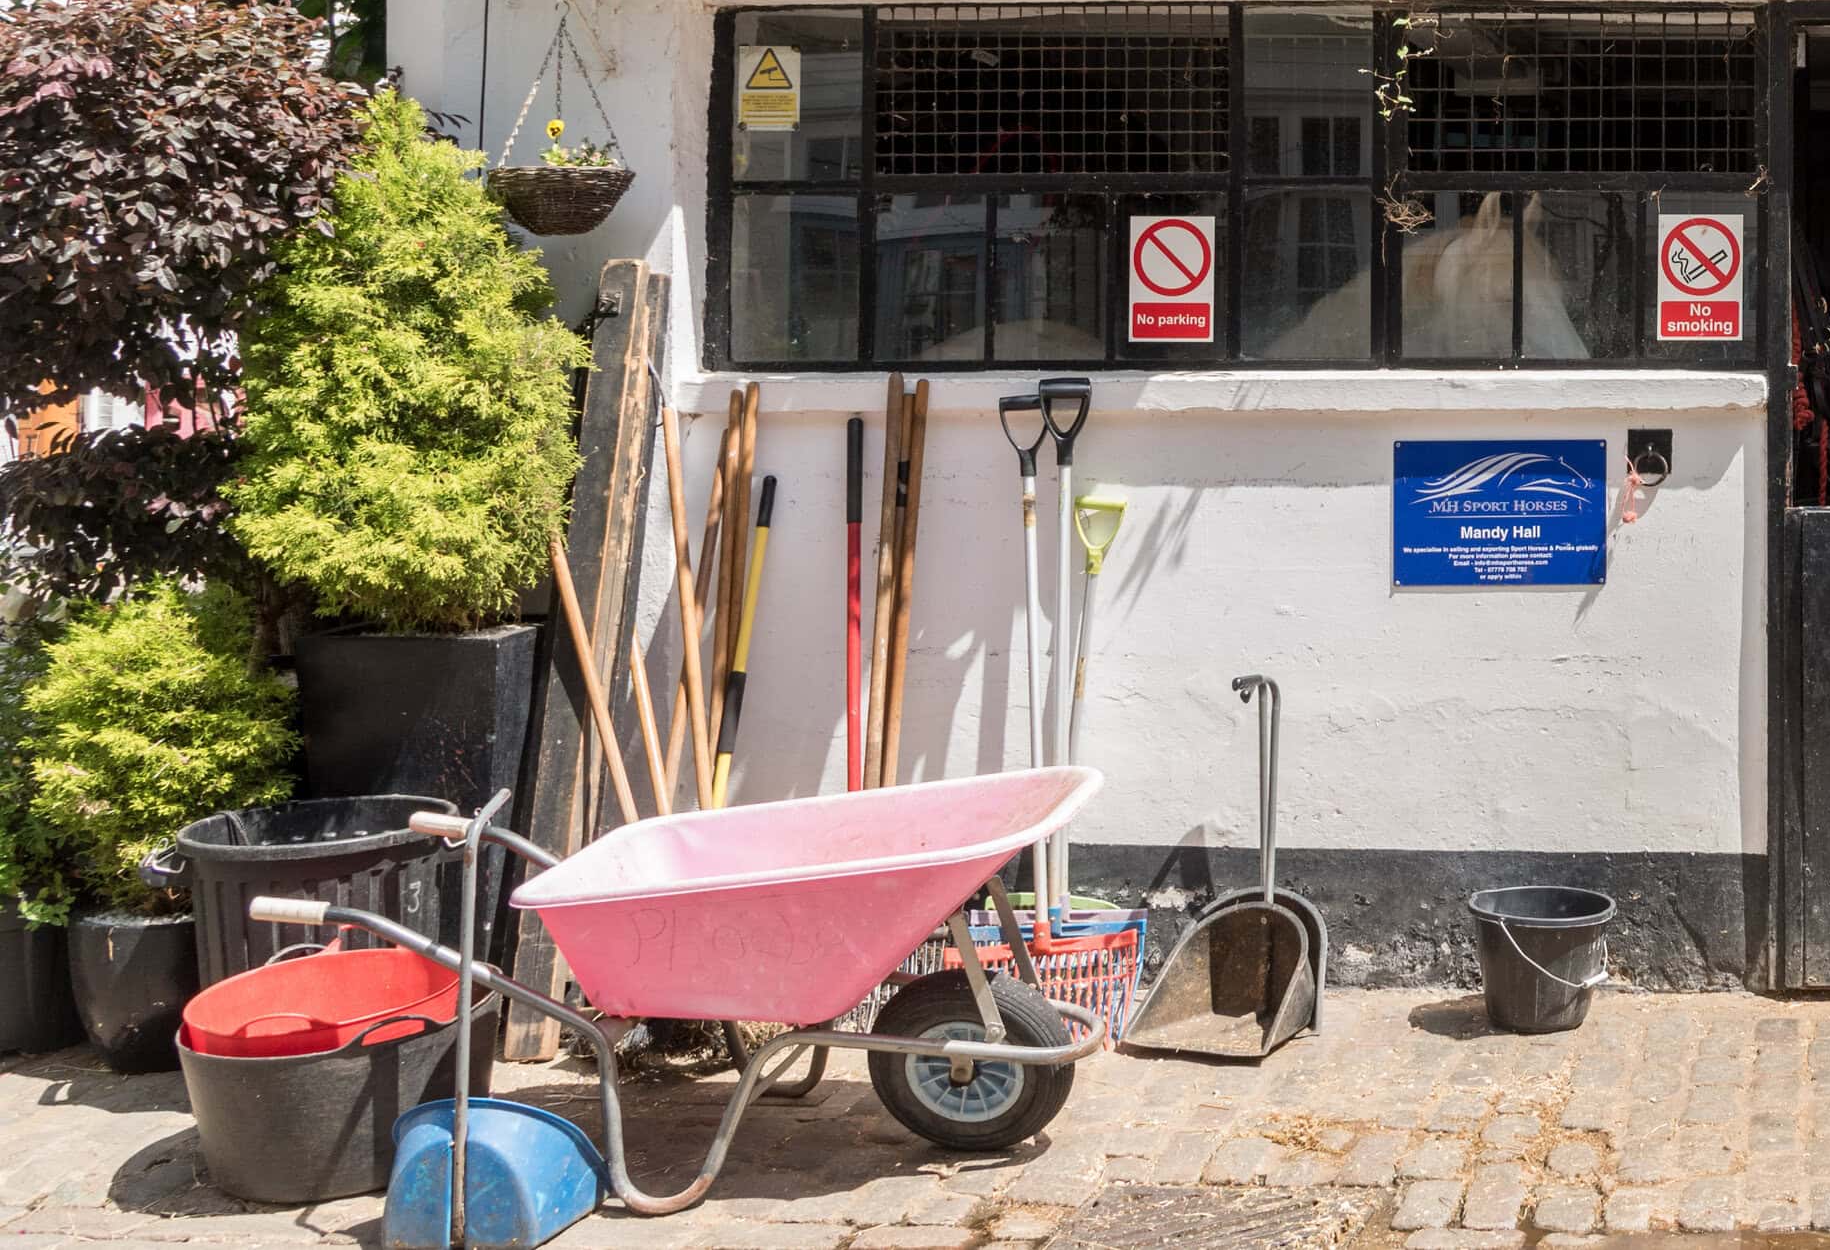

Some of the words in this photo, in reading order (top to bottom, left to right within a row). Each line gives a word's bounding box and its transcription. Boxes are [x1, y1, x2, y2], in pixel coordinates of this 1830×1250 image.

[1689, 303, 1712, 316] No
[1137, 313, 1155, 325] No
[1158, 313, 1206, 328] parking
[1667, 318, 1733, 335] smoking
[1431, 500, 1460, 513] MH
[1463, 500, 1510, 512] SPORT
[1513, 499, 1568, 512] HORSES
[1460, 525, 1508, 541] Mandy
[1512, 525, 1541, 539] Hall
